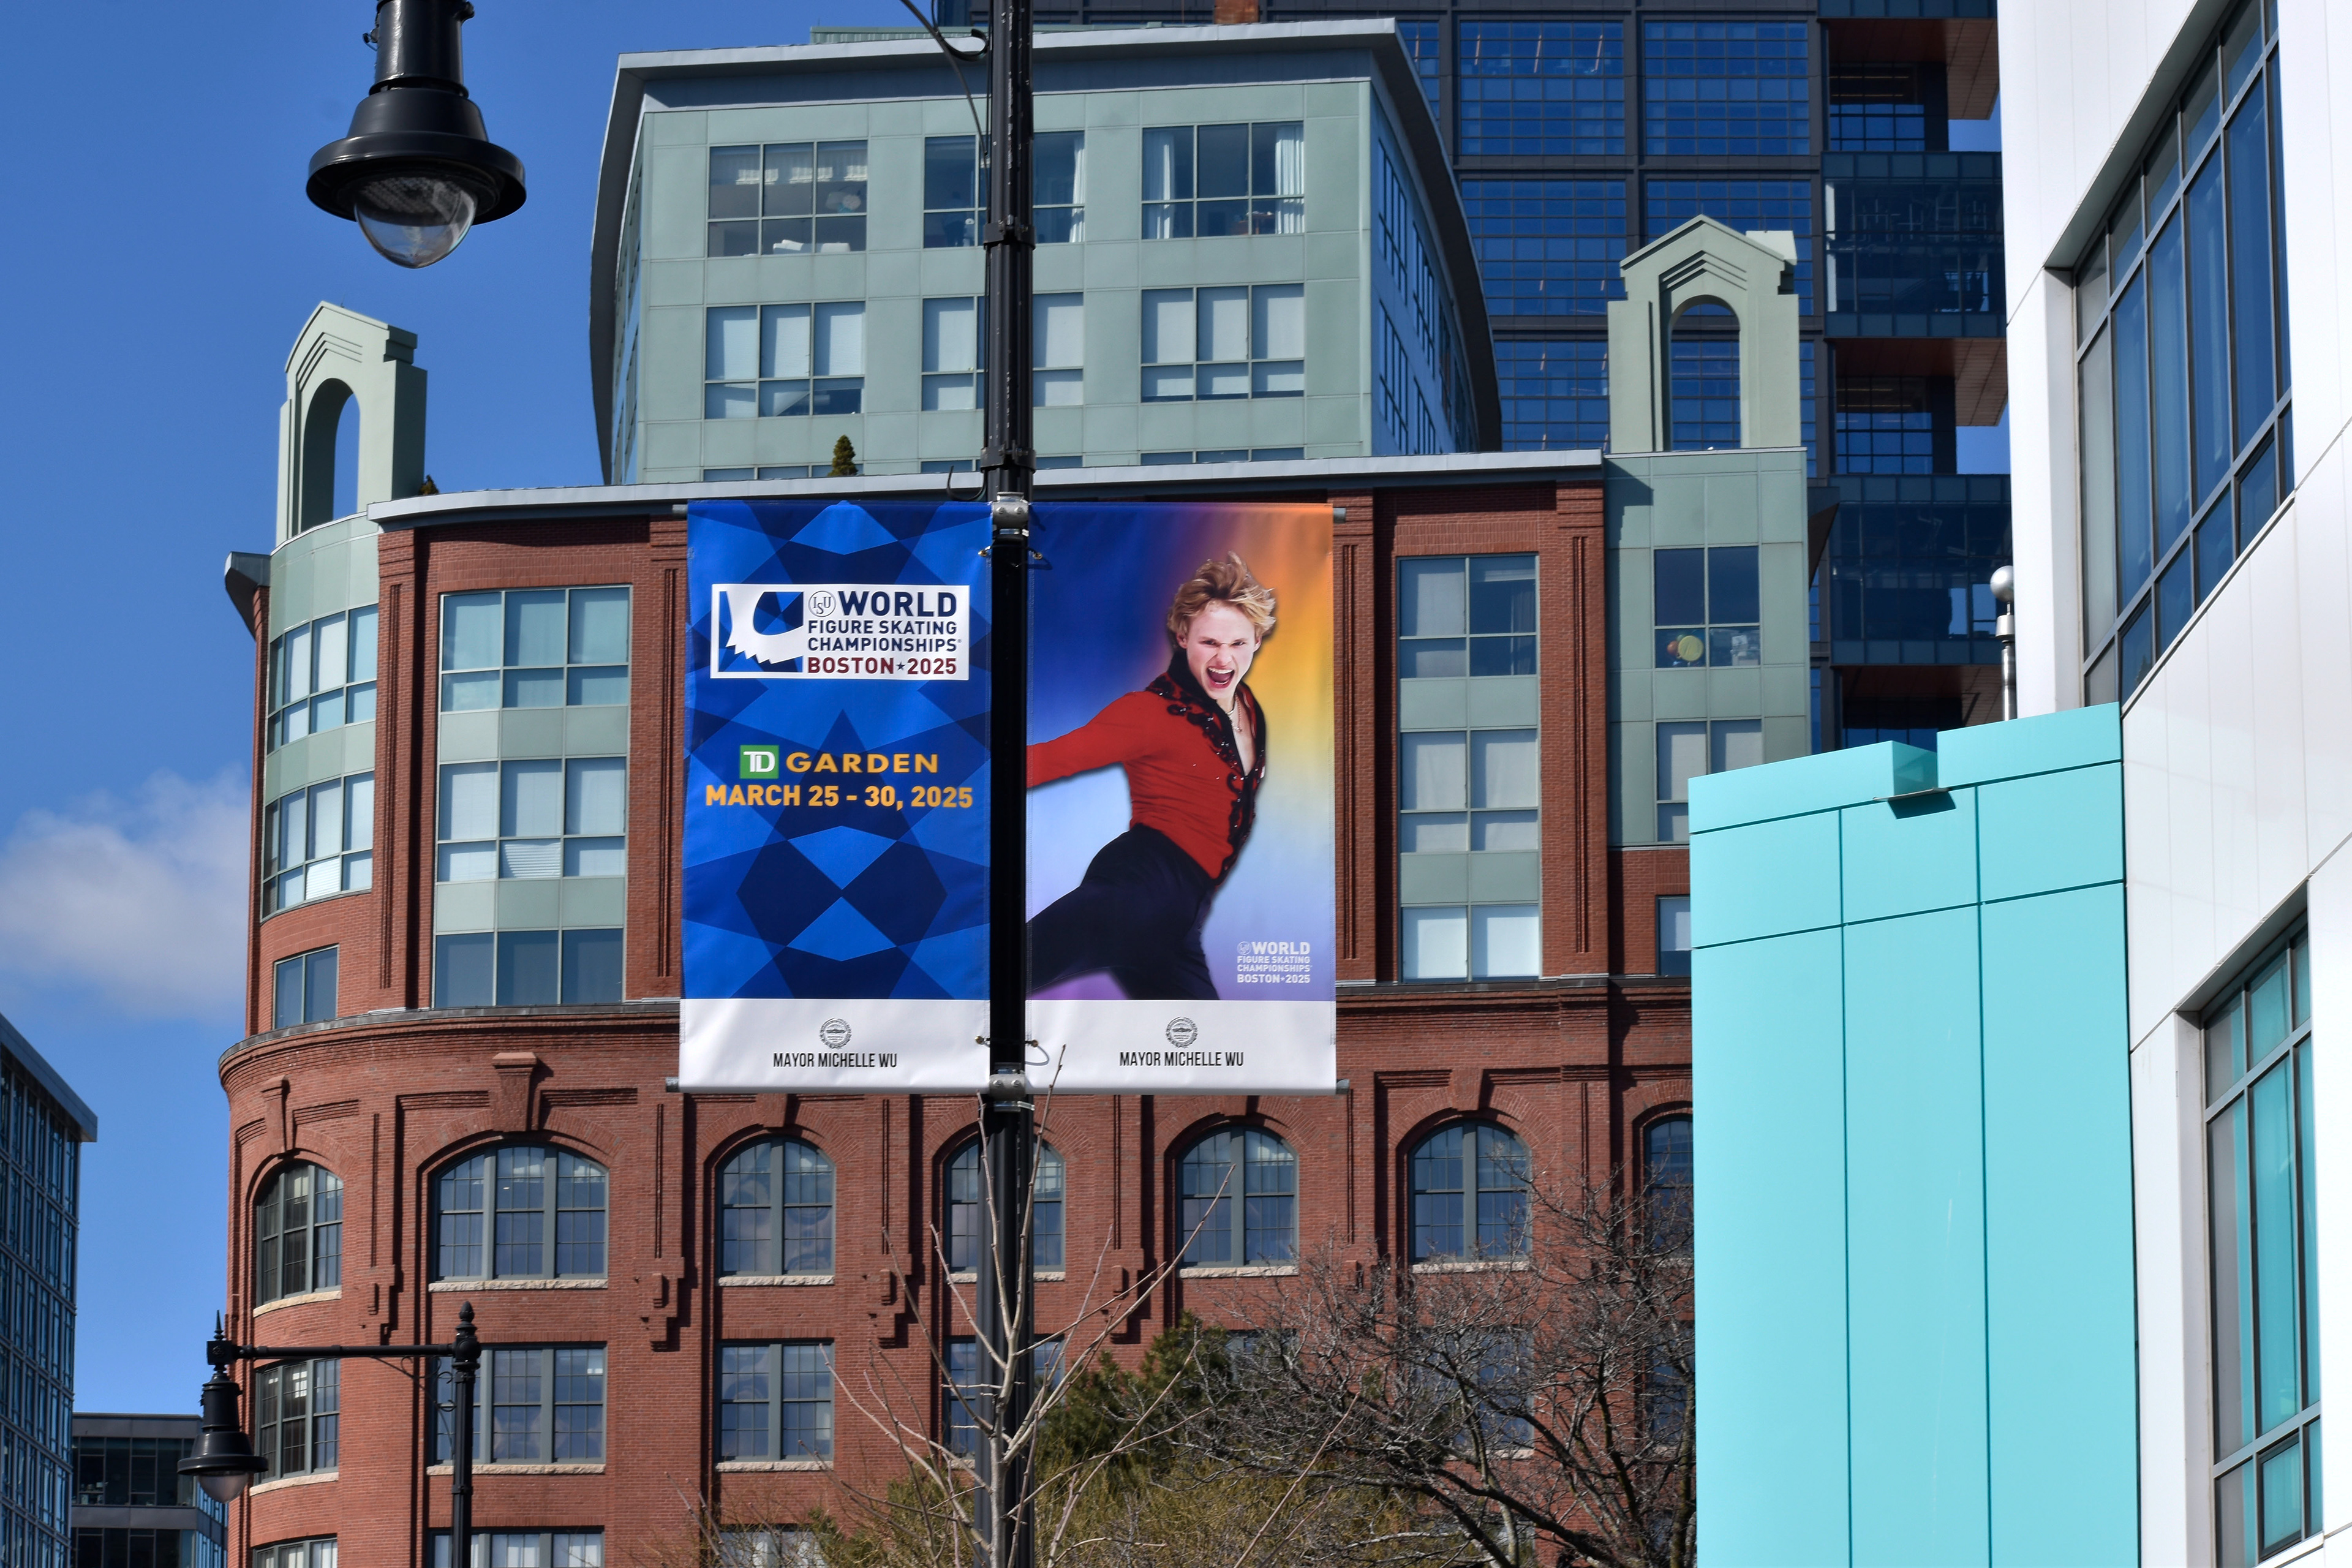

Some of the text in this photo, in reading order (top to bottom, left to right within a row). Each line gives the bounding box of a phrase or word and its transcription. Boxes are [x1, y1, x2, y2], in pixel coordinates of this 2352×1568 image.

[812, 590, 957, 617] ISU WORLD
[809, 620, 957, 635] FIGURE SKATING
[808, 657, 956, 675] BOSTON 2025
[744, 751, 938, 773] TD GARDEN
[706, 785, 801, 806] MARCH
[809, 786, 839, 807] 25
[864, 786, 903, 811] 30,
[911, 786, 973, 808] 2025
[1251, 941, 1310, 955] WORLD
[1237, 974, 1311, 984] BOSTON 2025
[774, 1053, 897, 1067] MAYOR MICHELLE WU
[1120, 1052, 1243, 1066] MAYOR MICHELLE WU
